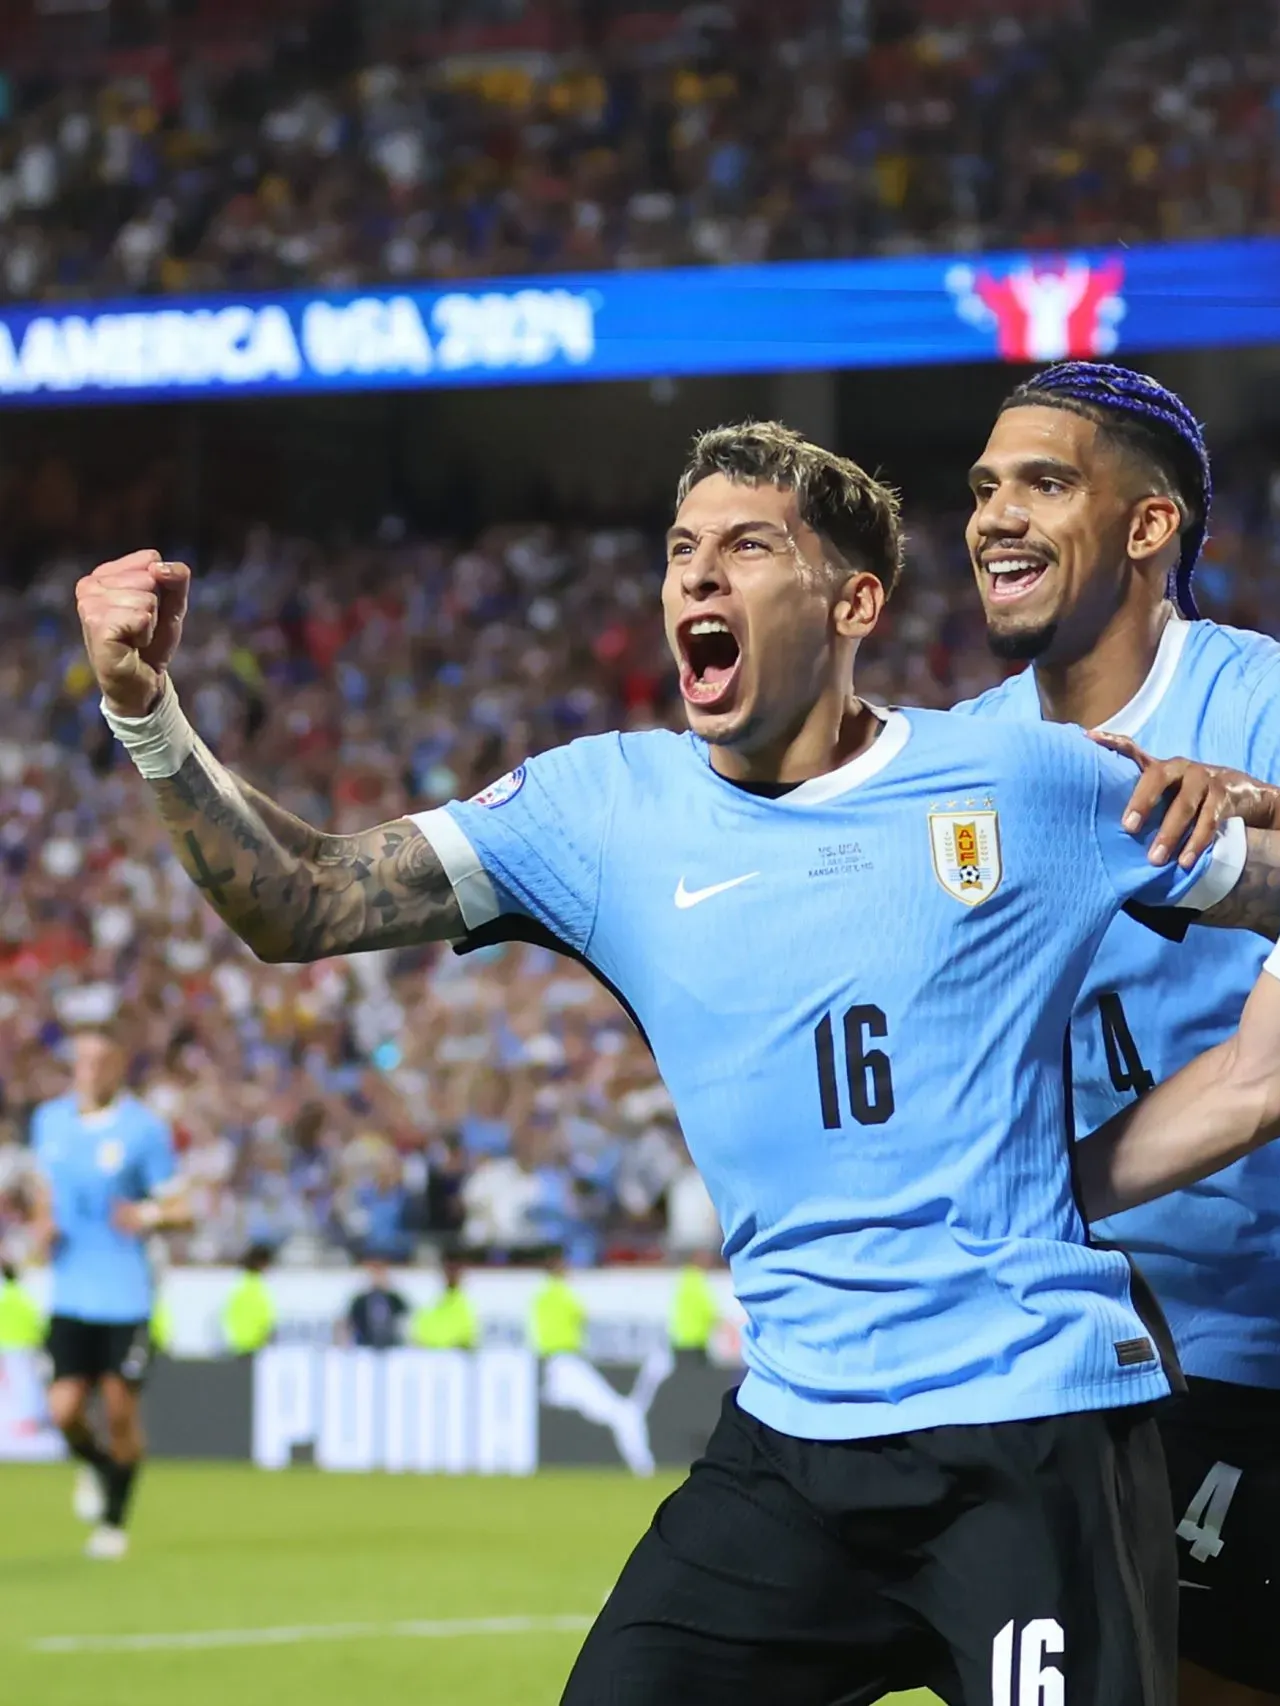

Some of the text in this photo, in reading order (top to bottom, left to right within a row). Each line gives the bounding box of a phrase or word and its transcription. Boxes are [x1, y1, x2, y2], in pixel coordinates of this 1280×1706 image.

[19, 305, 301, 393] AMERICA
[302, 296, 434, 376] USA
[431, 289, 596, 370] 2024
[958, 829, 975, 862] AUF
[814, 1003, 895, 1129] 16
[1098, 992, 1155, 1098] 4
[253, 1346, 538, 1476] PUMA
[1175, 1461, 1243, 1563] 4
[992, 1618, 1065, 1706] 16
